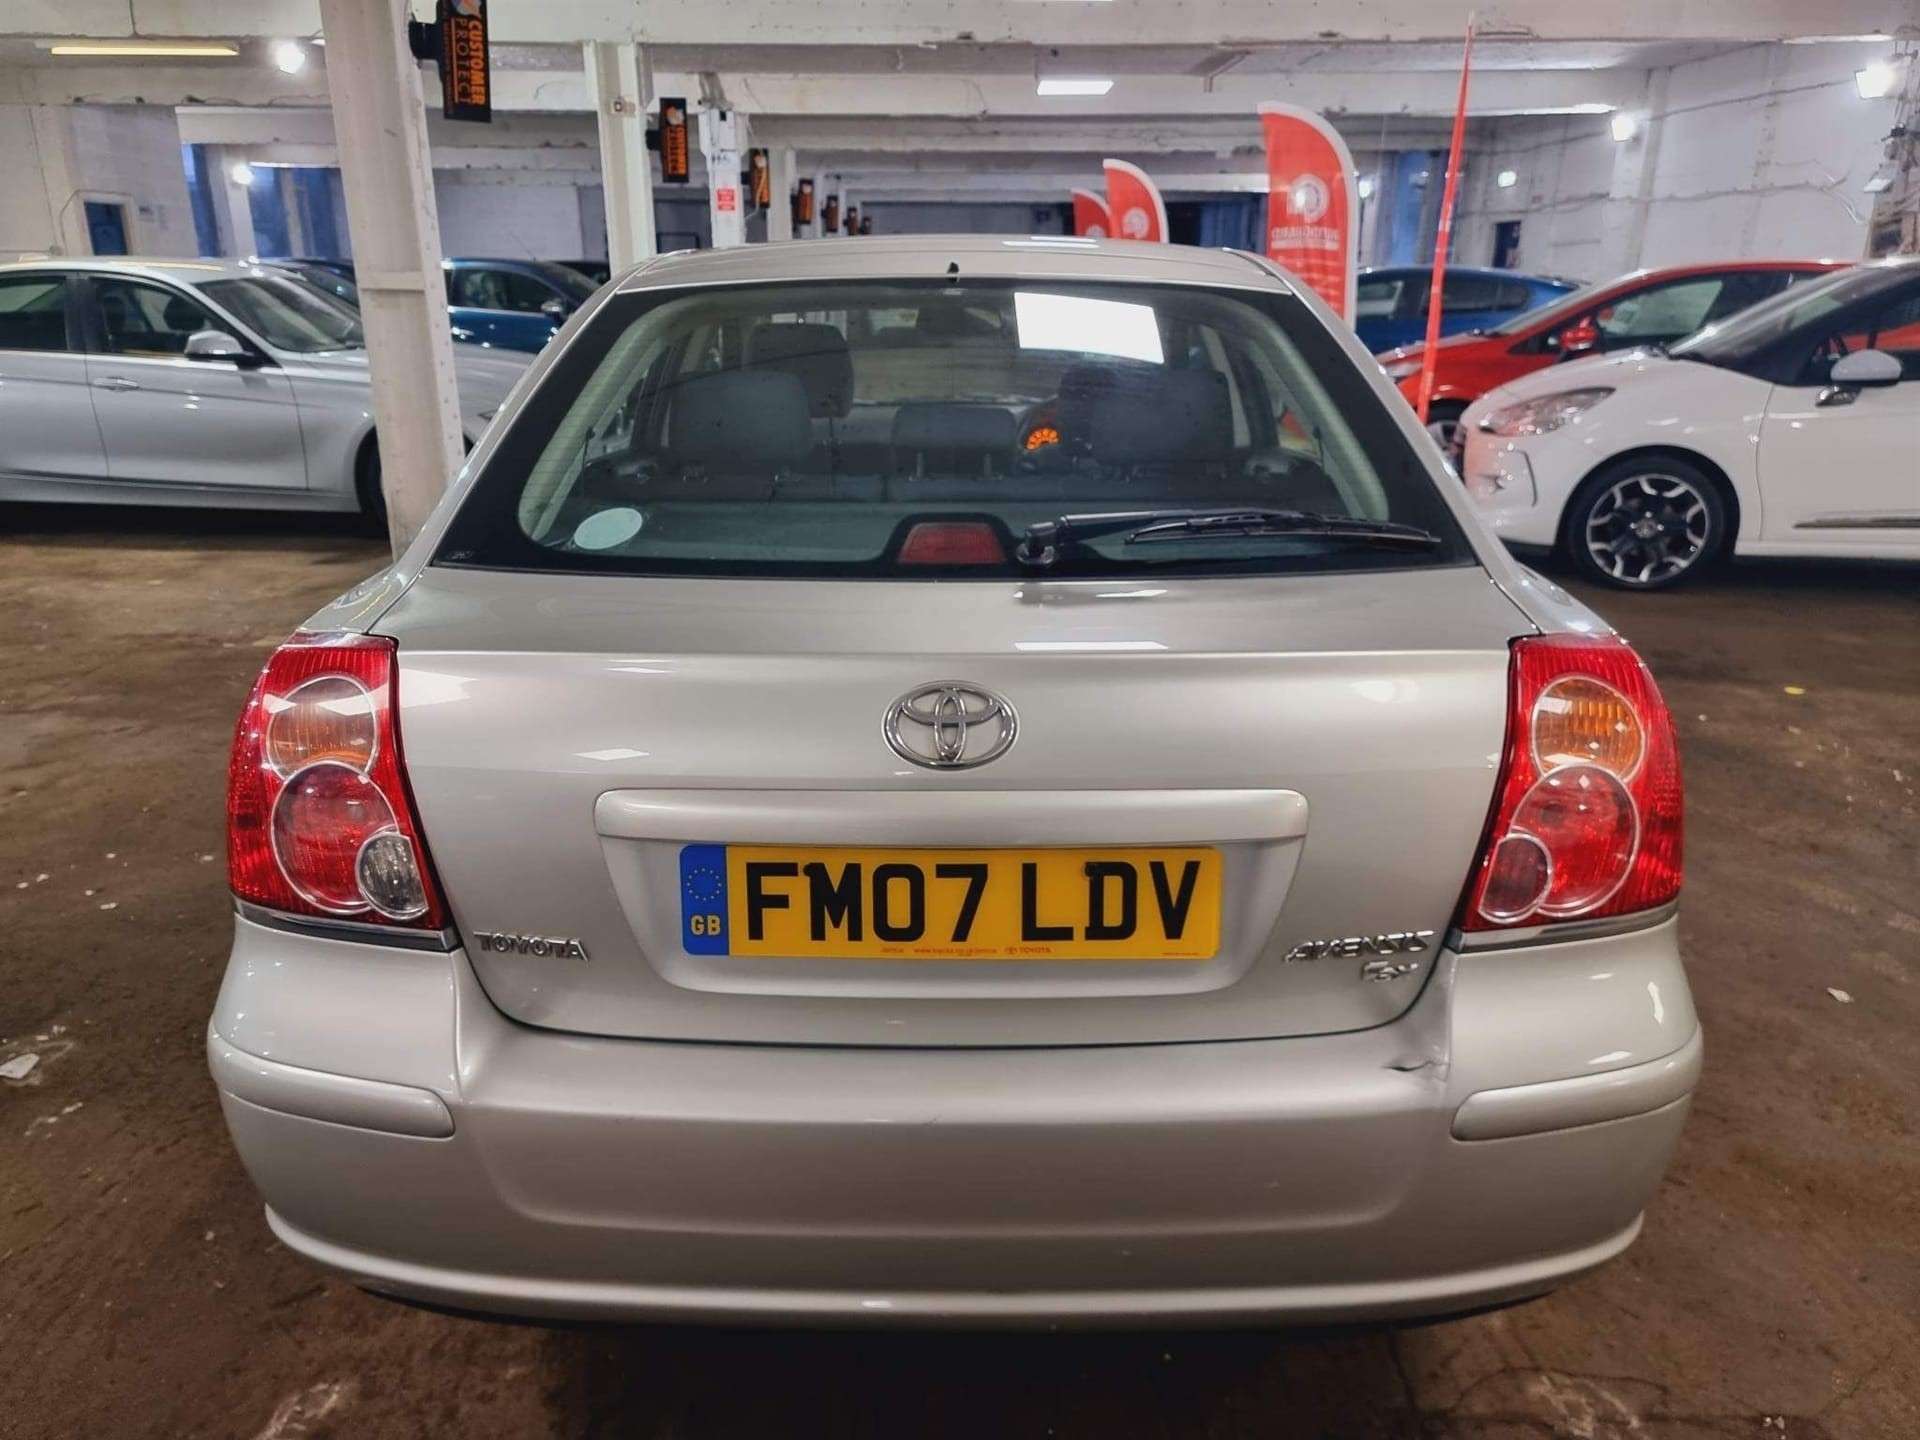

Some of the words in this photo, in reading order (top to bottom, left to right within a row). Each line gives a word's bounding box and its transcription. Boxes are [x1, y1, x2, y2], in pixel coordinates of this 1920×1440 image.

[456, 17, 471, 103] PROTECT
[468, 20, 486, 105] CUSTOMER
[691, 914, 721, 936] GB
[745, 861, 988, 943] FM07
[1021, 860, 1202, 941] LDV
[473, 930, 589, 963] TOYOTA
[1284, 930, 1434, 964] AVENSIS
